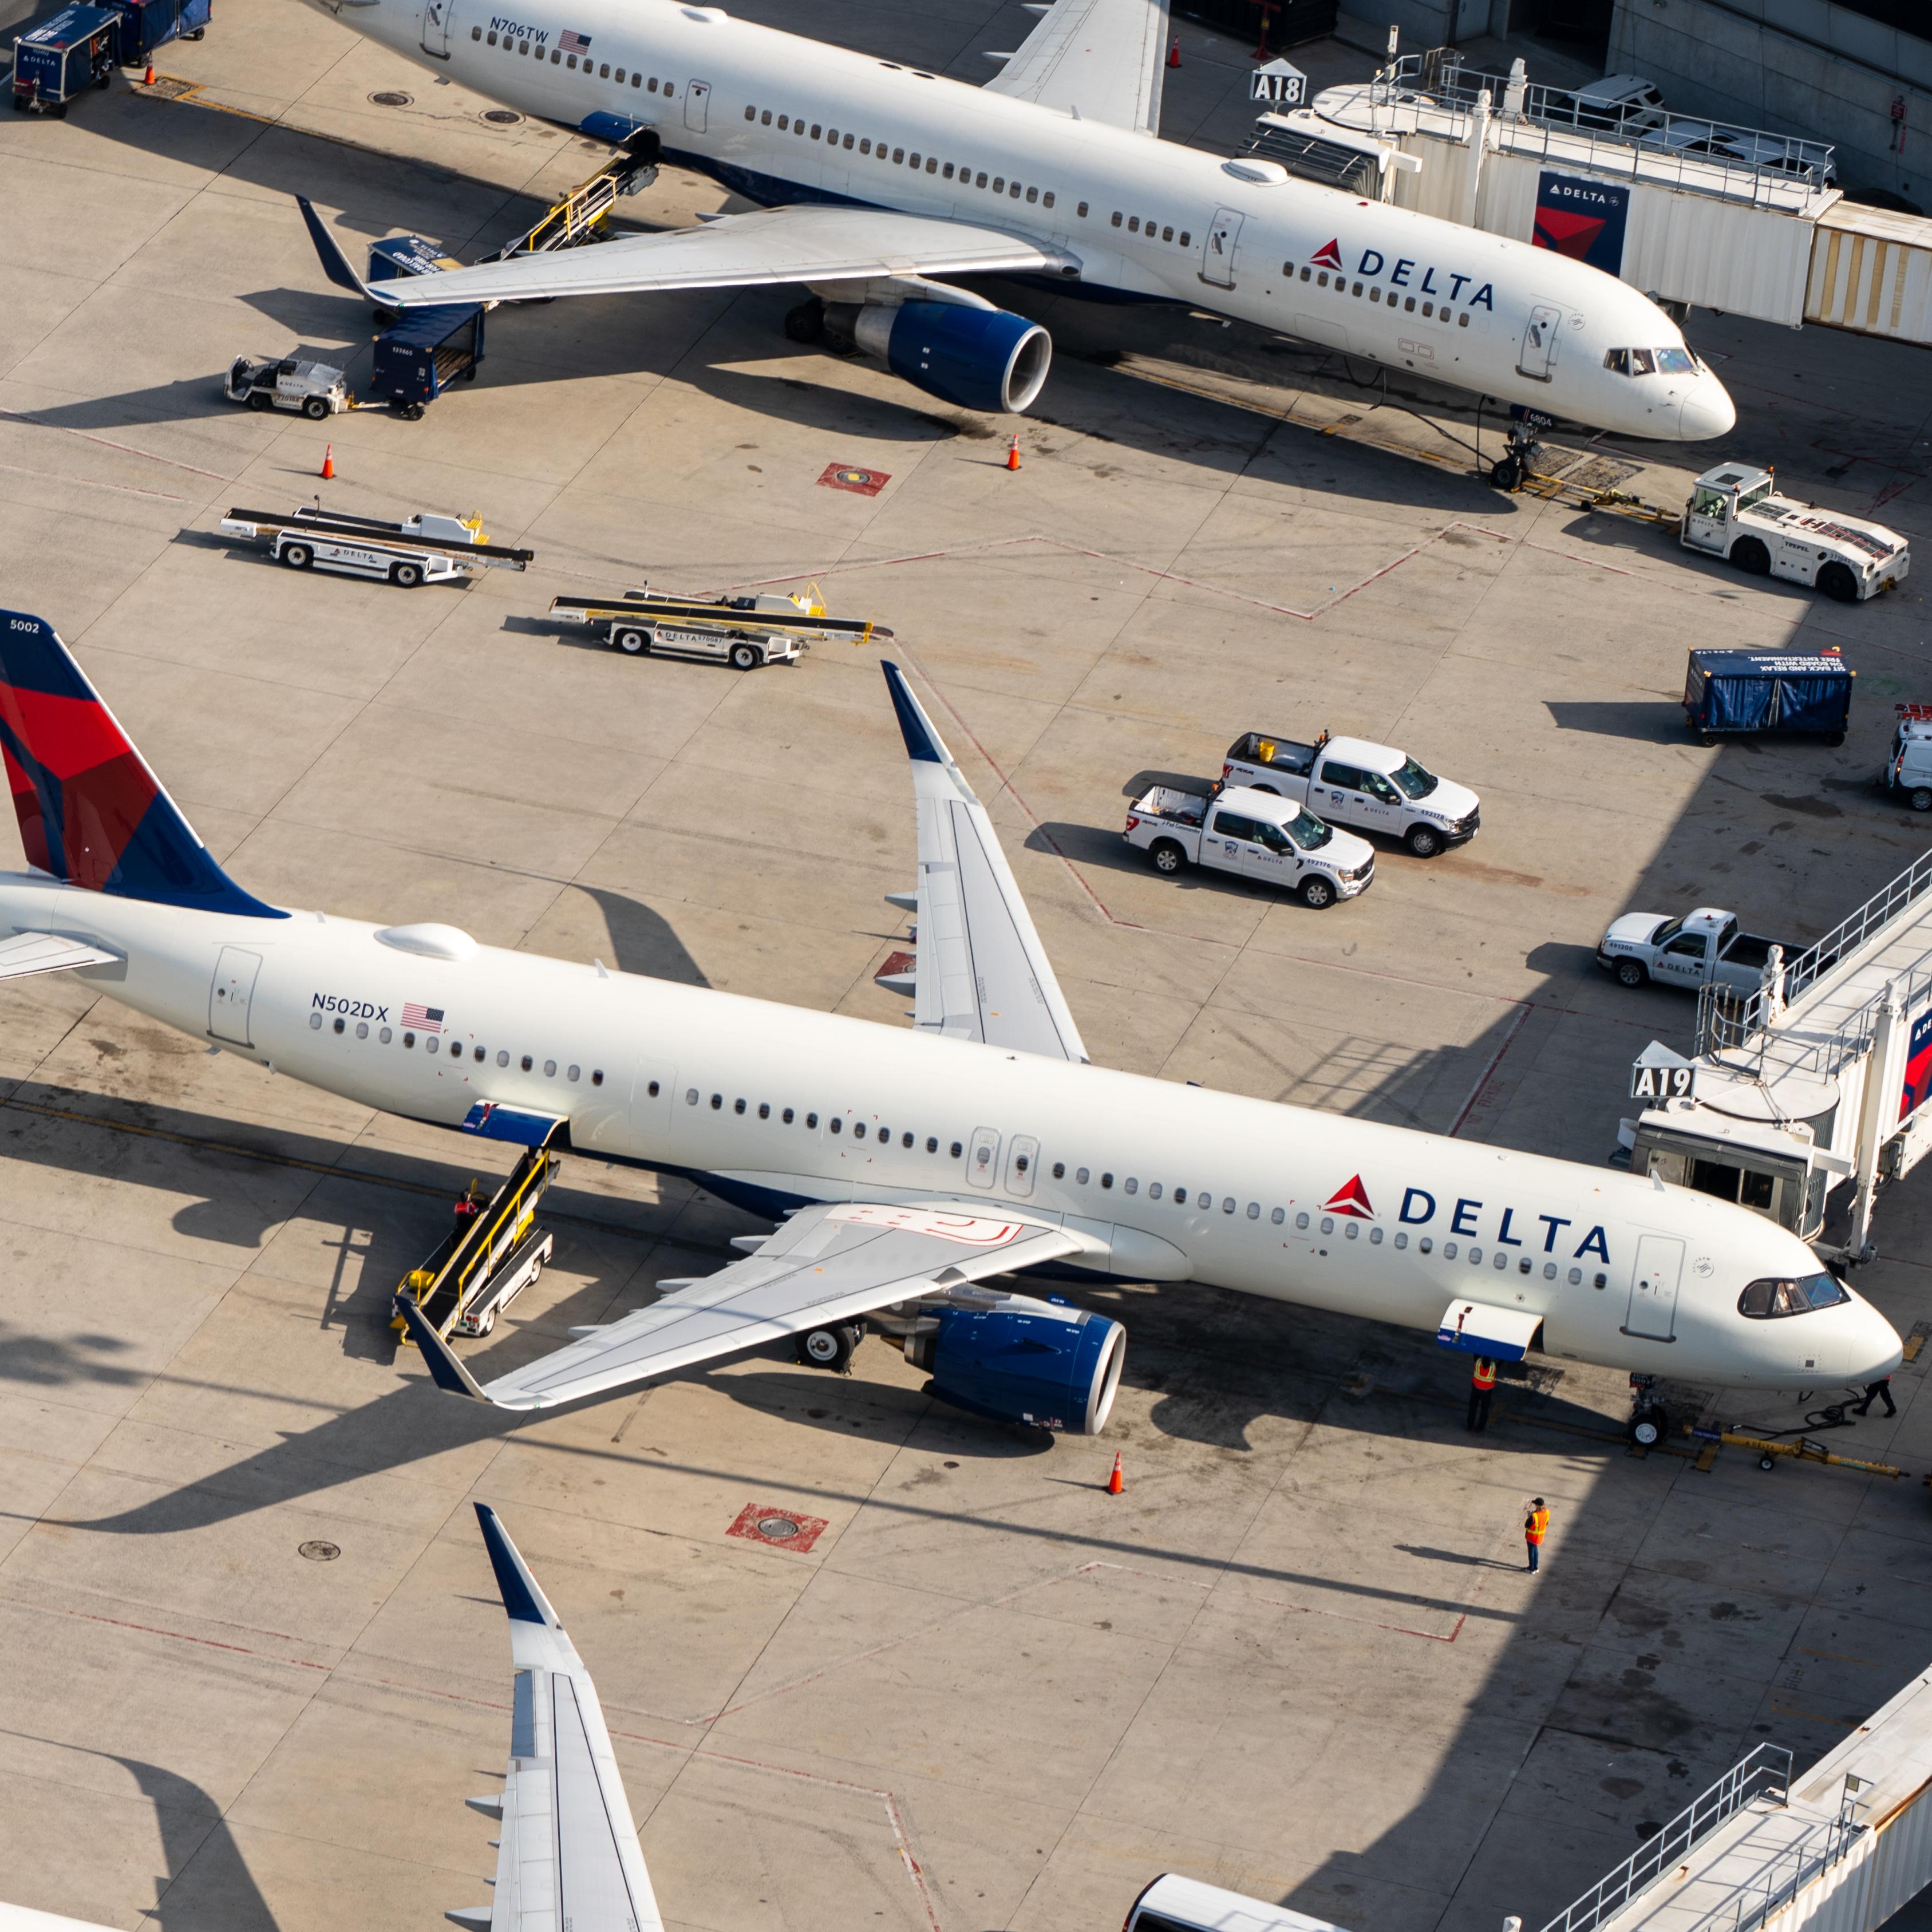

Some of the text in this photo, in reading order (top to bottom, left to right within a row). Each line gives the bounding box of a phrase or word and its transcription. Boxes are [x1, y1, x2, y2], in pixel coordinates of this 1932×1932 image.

[489, 17, 549, 44] N706TW
[30, 57, 56, 67] DELTA
[1254, 75, 1300, 102] A18
[1563, 187, 1606, 204] DELTA
[1357, 249, 1493, 311] DELTA
[1530, 413, 1552, 426] 6804
[1697, 519, 1714, 528] DELTA
[1785, 541, 1809, 552] TREPEL
[343, 549, 374, 560] DELTA
[10, 619, 39, 634] 5002
[666, 631, 697, 642] DELTA
[1420, 809, 1445, 820] 492178
[1263, 856, 1282, 865] DELTA
[1306, 858, 1332, 868] 492176
[1667, 963, 1700, 976] DELTA
[312, 993, 389, 1022] N502DX
[1635, 1068, 1690, 1096] A19
[1398, 1187, 1610, 1265] DELTA
